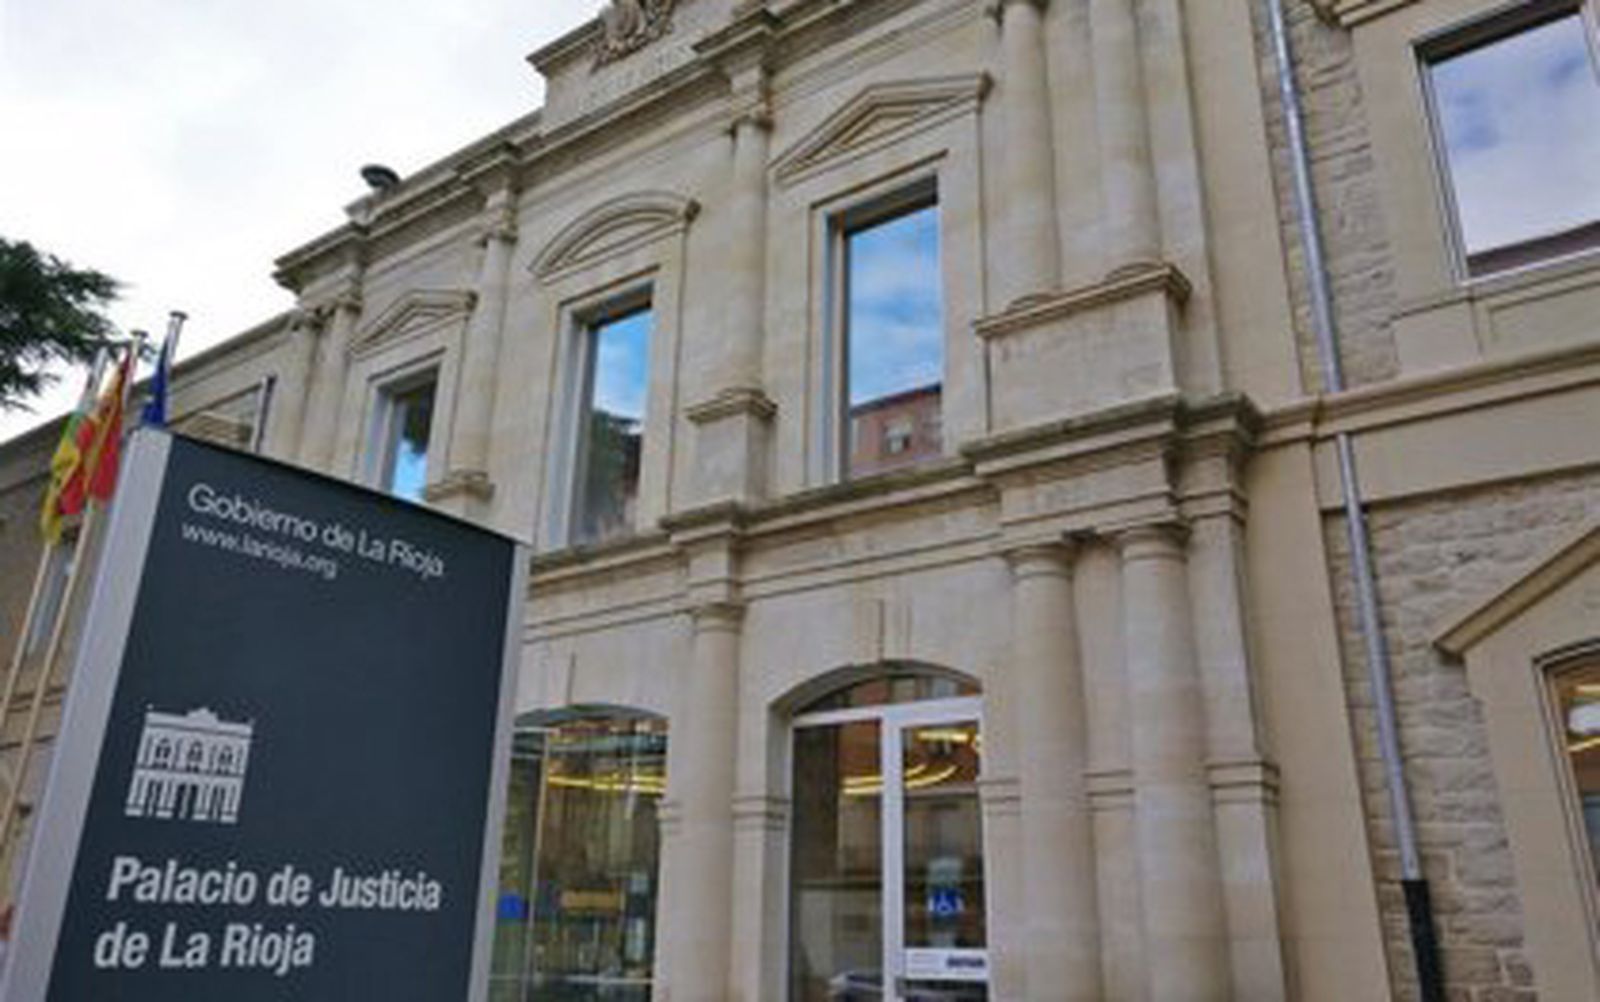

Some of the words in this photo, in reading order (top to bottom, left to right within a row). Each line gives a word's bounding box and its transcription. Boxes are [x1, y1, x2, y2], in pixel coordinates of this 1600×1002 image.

[180, 522, 338, 580] www.larioja.org
[187, 483, 318, 541] Gobierno
[322, 523, 354, 553] de
[357, 530, 385, 562] La
[388, 540, 445, 581] Rioja
[106, 855, 258, 905] Palacio
[266, 865, 312, 906] de
[319, 868, 442, 910] Justicia
[94, 922, 150, 969] de
[159, 922, 209, 969] La
[220, 924, 316, 976] Rioja
